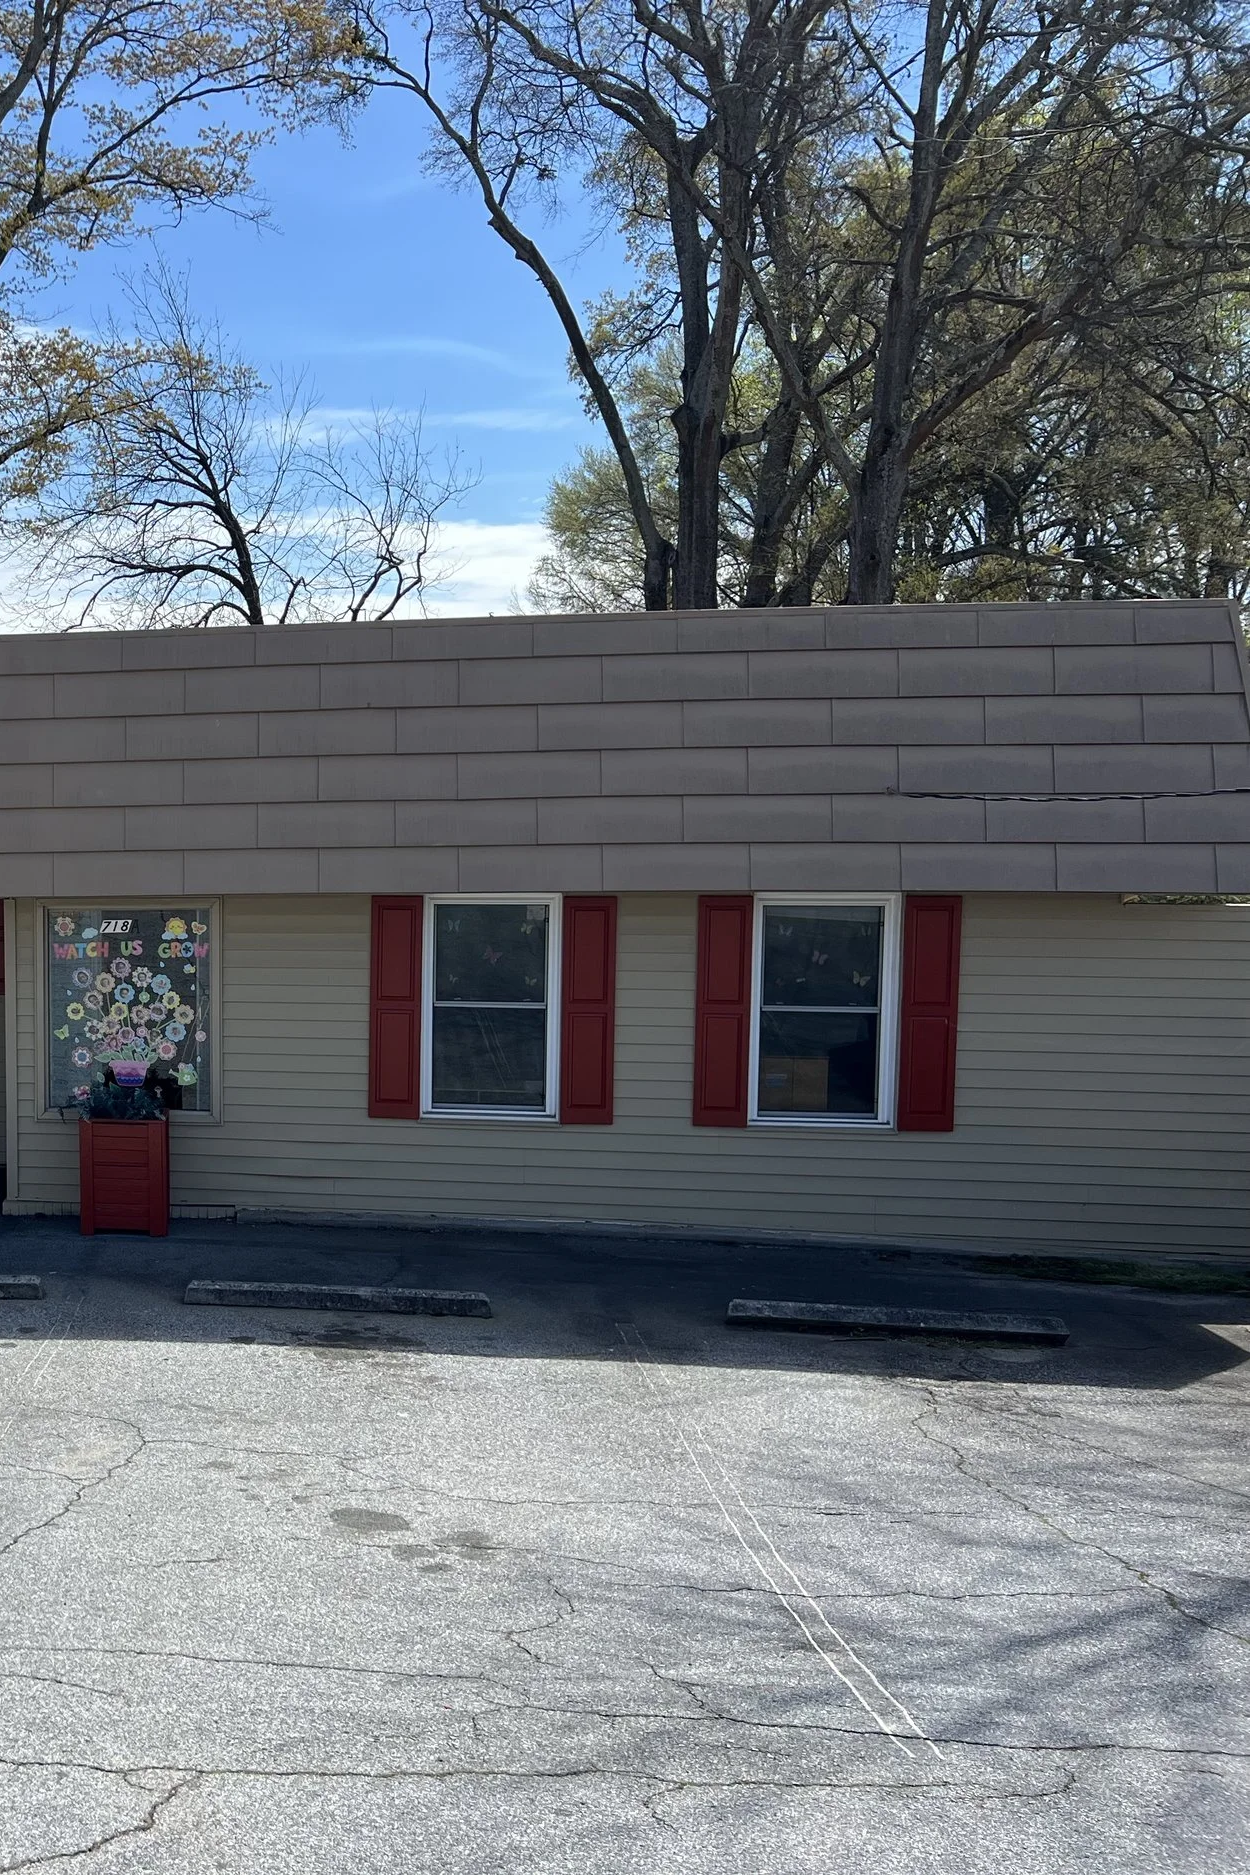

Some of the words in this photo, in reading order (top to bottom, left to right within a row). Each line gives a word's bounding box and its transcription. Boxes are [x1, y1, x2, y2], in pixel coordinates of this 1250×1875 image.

[53, 941, 109, 960] WATCH
[120, 940, 143, 956] US
[158, 941, 209, 959] GROW
